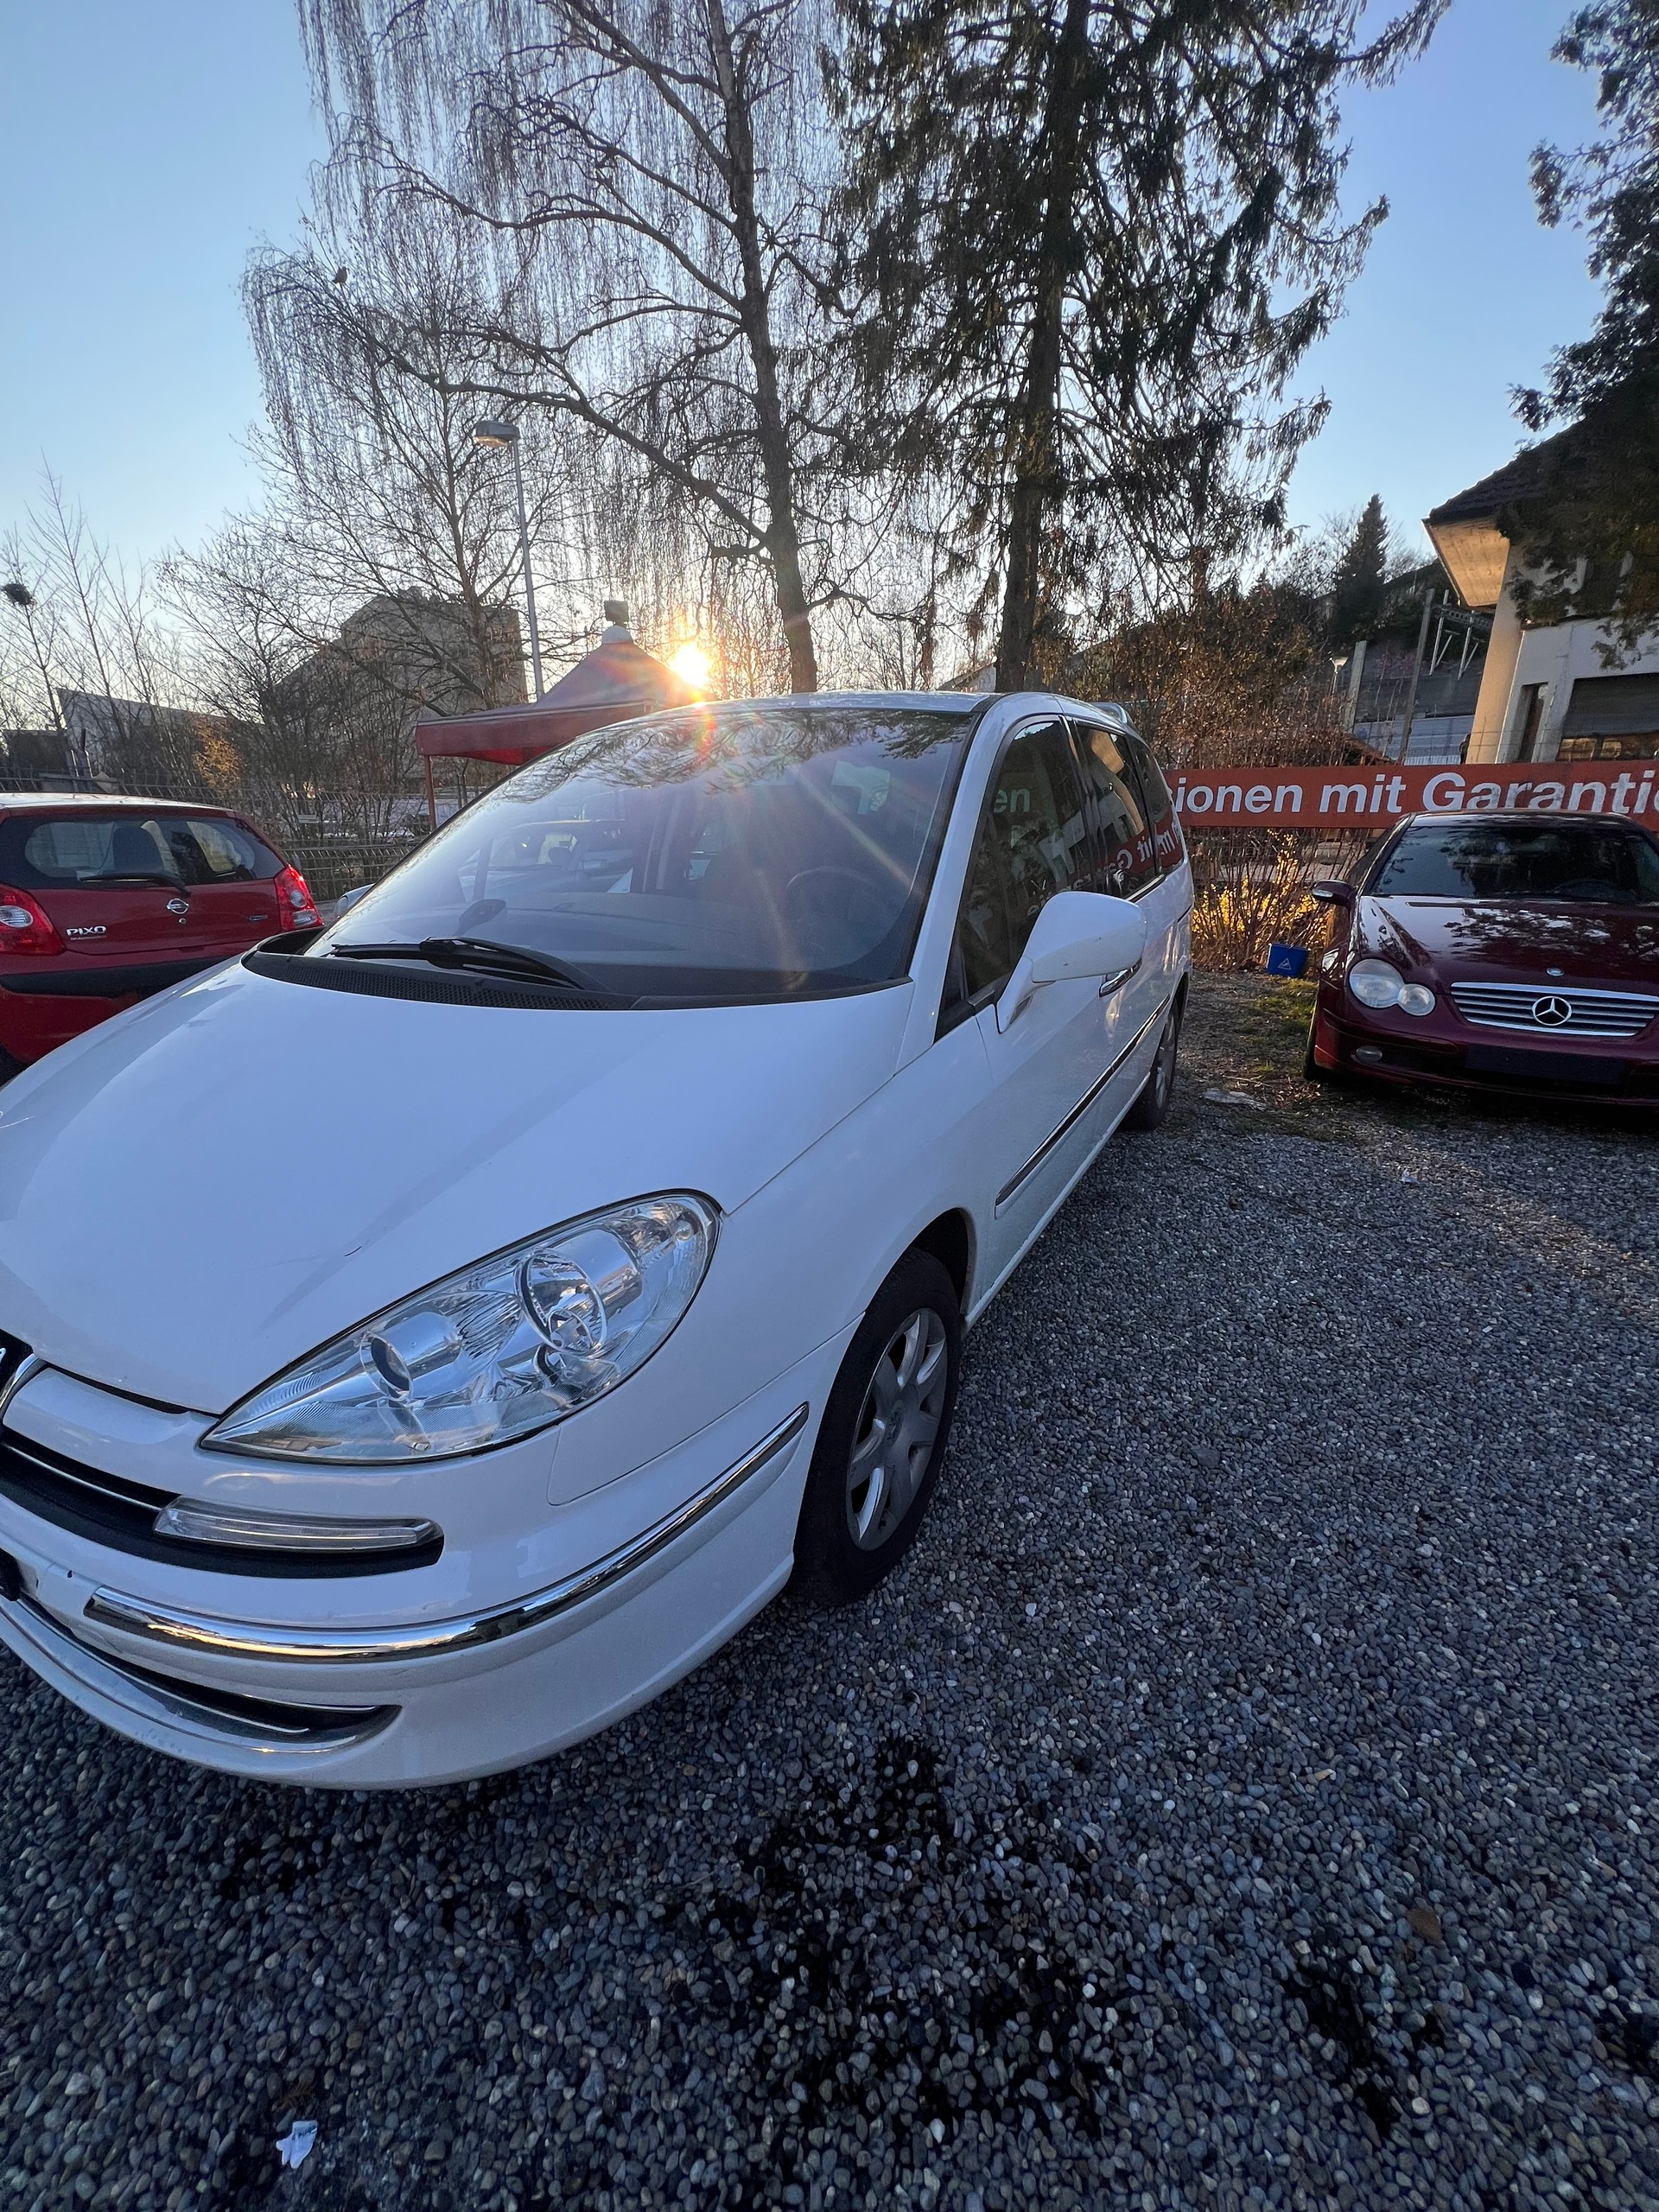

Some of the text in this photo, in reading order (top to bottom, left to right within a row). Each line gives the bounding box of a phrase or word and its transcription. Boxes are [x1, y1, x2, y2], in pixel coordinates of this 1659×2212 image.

[1168, 778, 1303, 812] ionen
[1319, 774, 1406, 813] mit
[67, 925, 106, 936] PIXO
